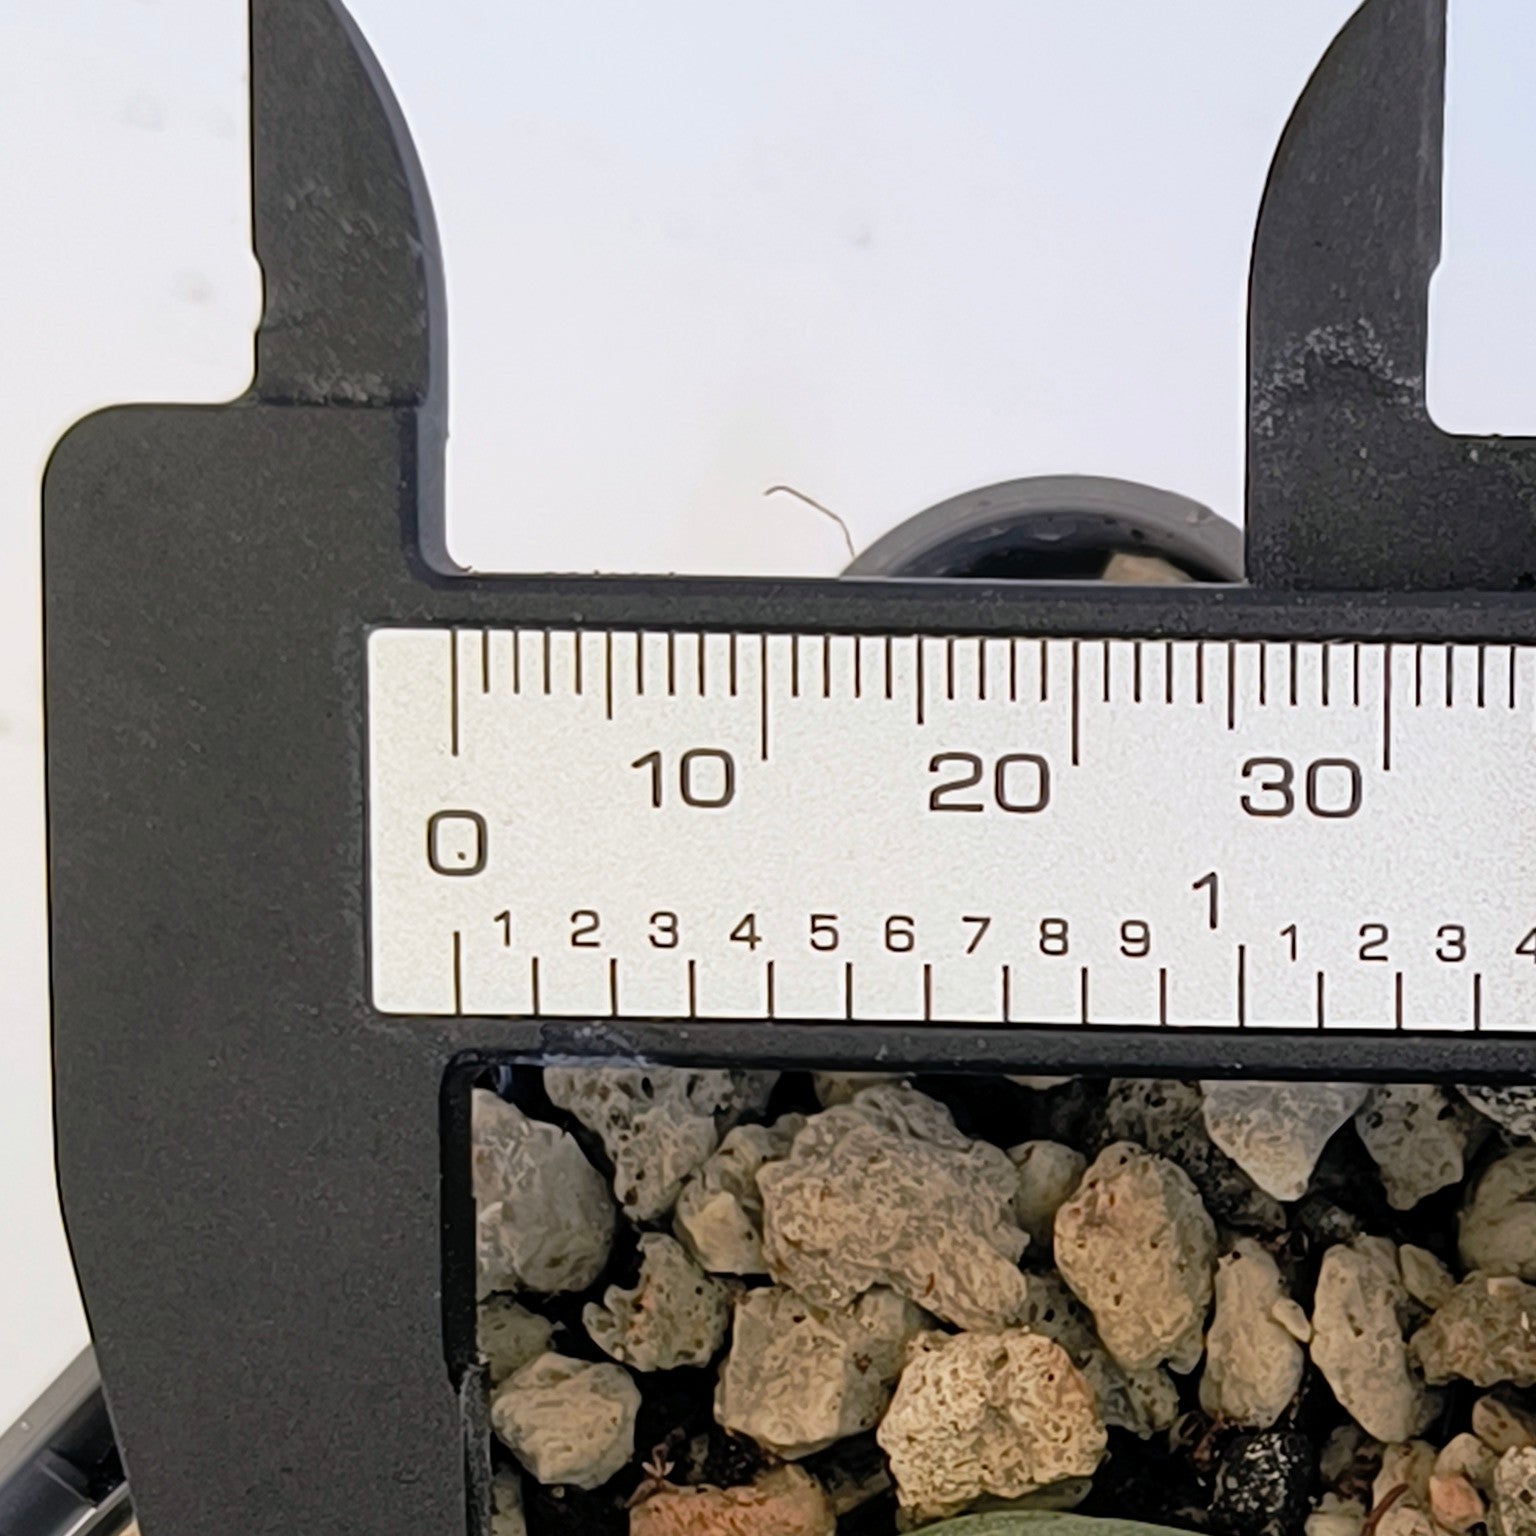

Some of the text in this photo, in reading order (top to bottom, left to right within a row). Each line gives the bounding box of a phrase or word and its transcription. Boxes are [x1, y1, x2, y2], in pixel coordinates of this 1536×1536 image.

[631, 747, 735, 809] 10
[928, 751, 1051, 814] 20
[1240, 756, 1363, 819] 30
[426, 809, 488, 876] 0
[1192, 871, 1218, 930] 1
[493, 910, 511, 947] 1
[570, 909, 601, 948] 2
[648, 911, 679, 949] 3
[729, 912, 762, 951] 4
[810, 913, 839, 952] 5
[884, 914, 915, 953] 6
[961, 915, 991, 955] 7
[1039, 917, 1069, 957] 8
[1119, 919, 1151, 958] 9
[1280, 923, 1297, 962] 1
[1358, 923, 1389, 962] 2
[1435, 924, 1467, 963] 3
